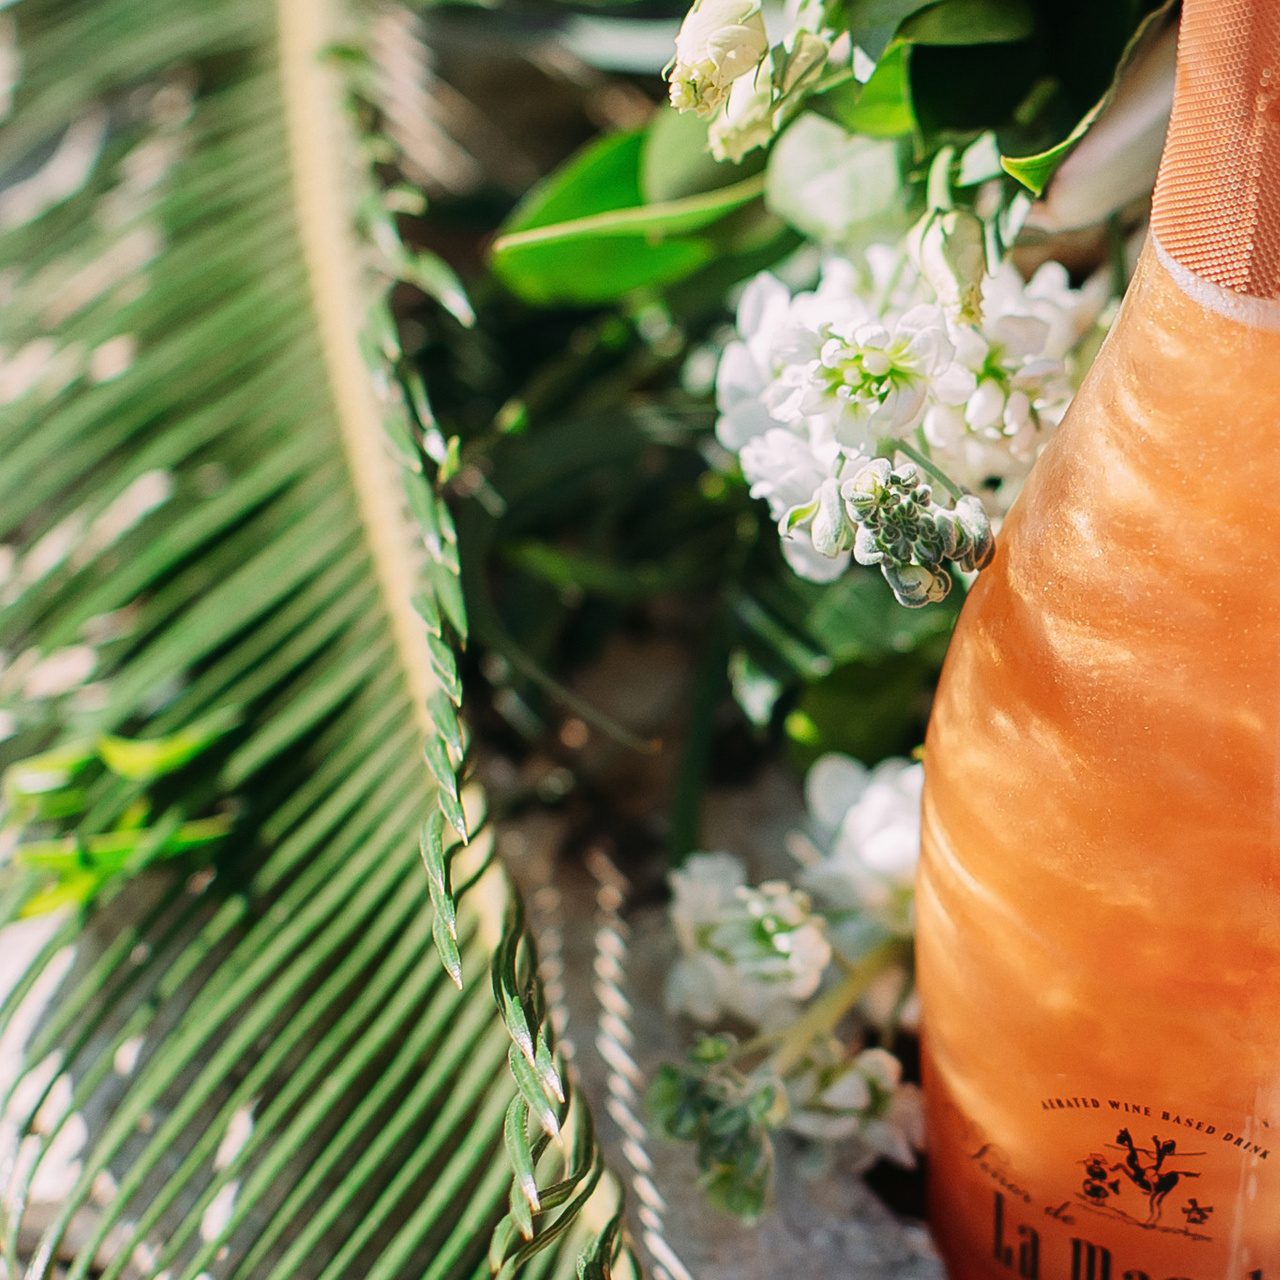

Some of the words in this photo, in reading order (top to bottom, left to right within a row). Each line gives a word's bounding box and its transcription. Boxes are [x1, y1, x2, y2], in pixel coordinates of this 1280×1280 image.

[1040, 1097, 1101, 1111] AERATED
[1107, 1099, 1152, 1117] WINE
[1160, 1110, 1217, 1136] BASED
[1222, 1132, 1272, 1161] DRINK
